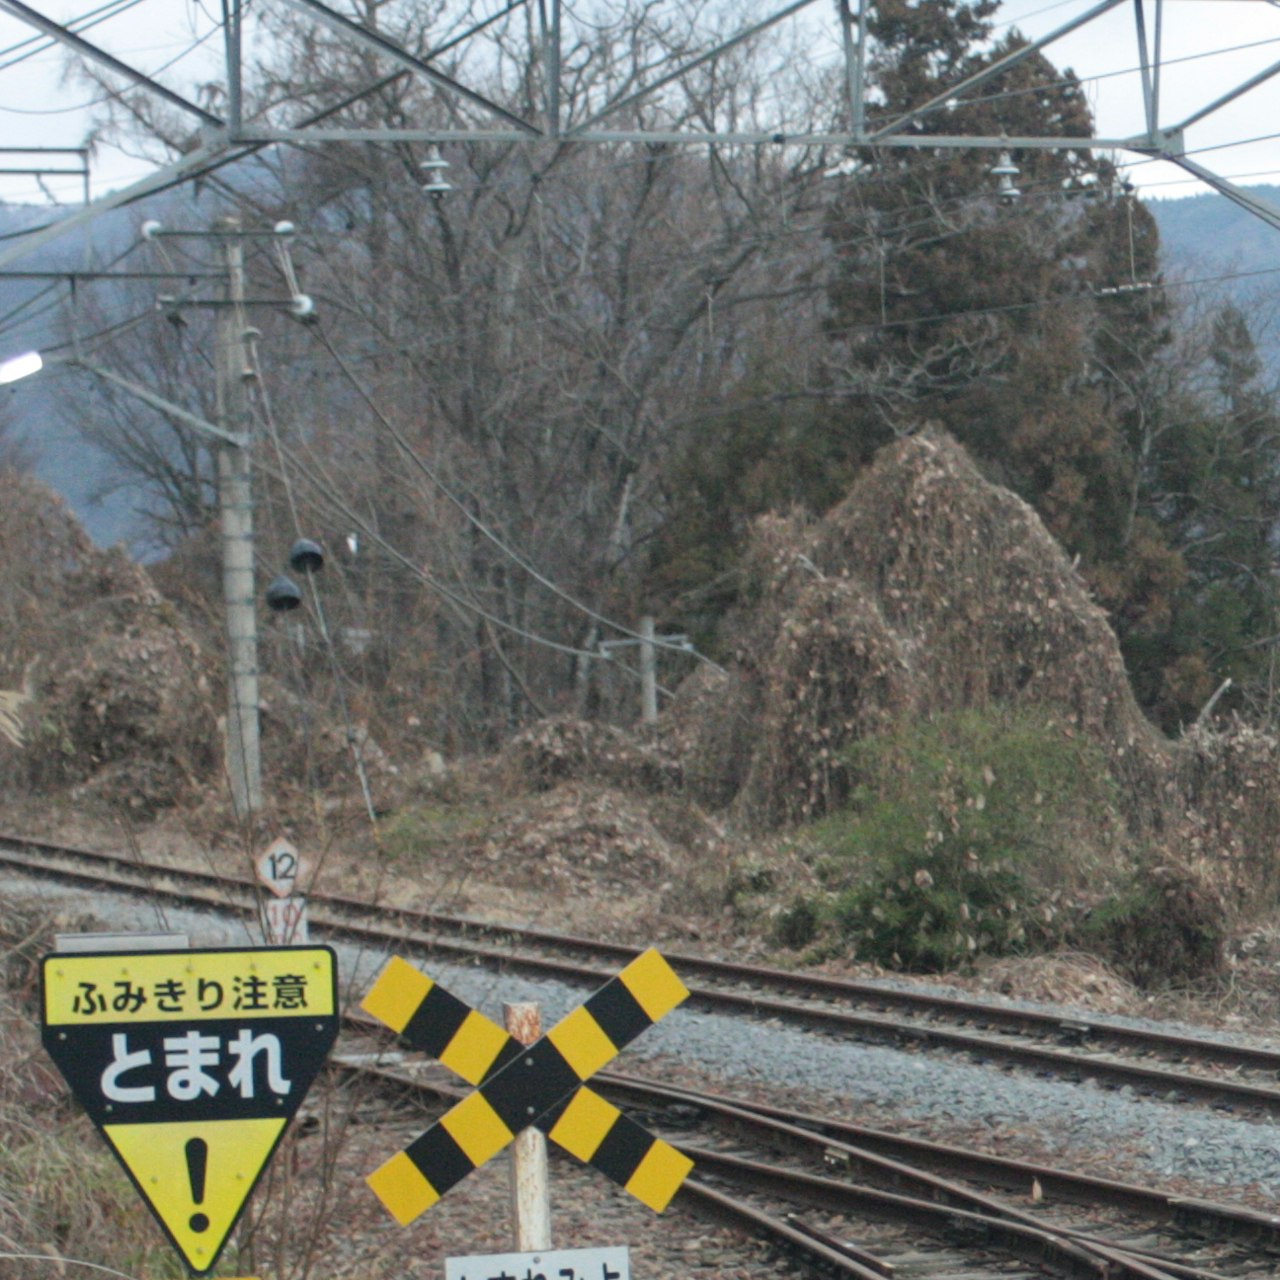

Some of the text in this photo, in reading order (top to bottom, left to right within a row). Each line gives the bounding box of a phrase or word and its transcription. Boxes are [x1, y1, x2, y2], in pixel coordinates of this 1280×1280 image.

[268, 853, 296, 880] 12
[73, 974, 308, 1015] ふみきり注意
[101, 1029, 292, 1103] とまれ
